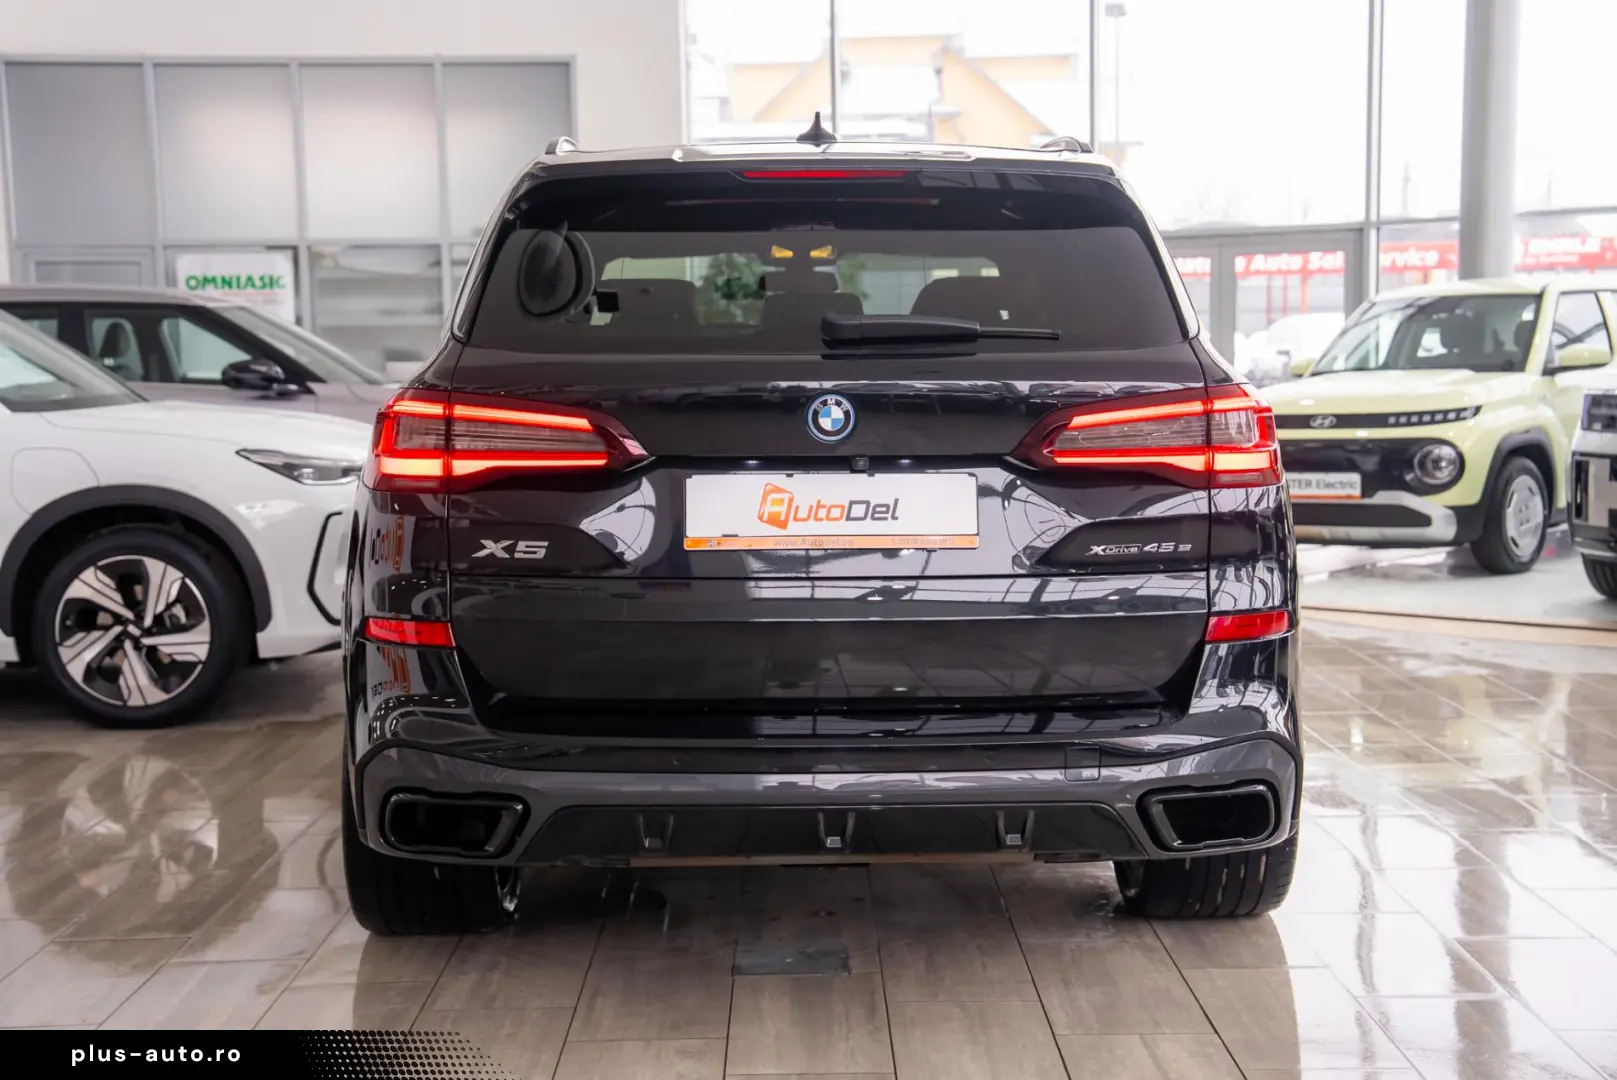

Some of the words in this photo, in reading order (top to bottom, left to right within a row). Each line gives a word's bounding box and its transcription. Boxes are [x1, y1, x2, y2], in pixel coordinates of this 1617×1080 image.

[1316, 479, 1358, 491] Electric
[759, 490, 900, 525] AutoDel
[471, 539, 549, 559] X5
